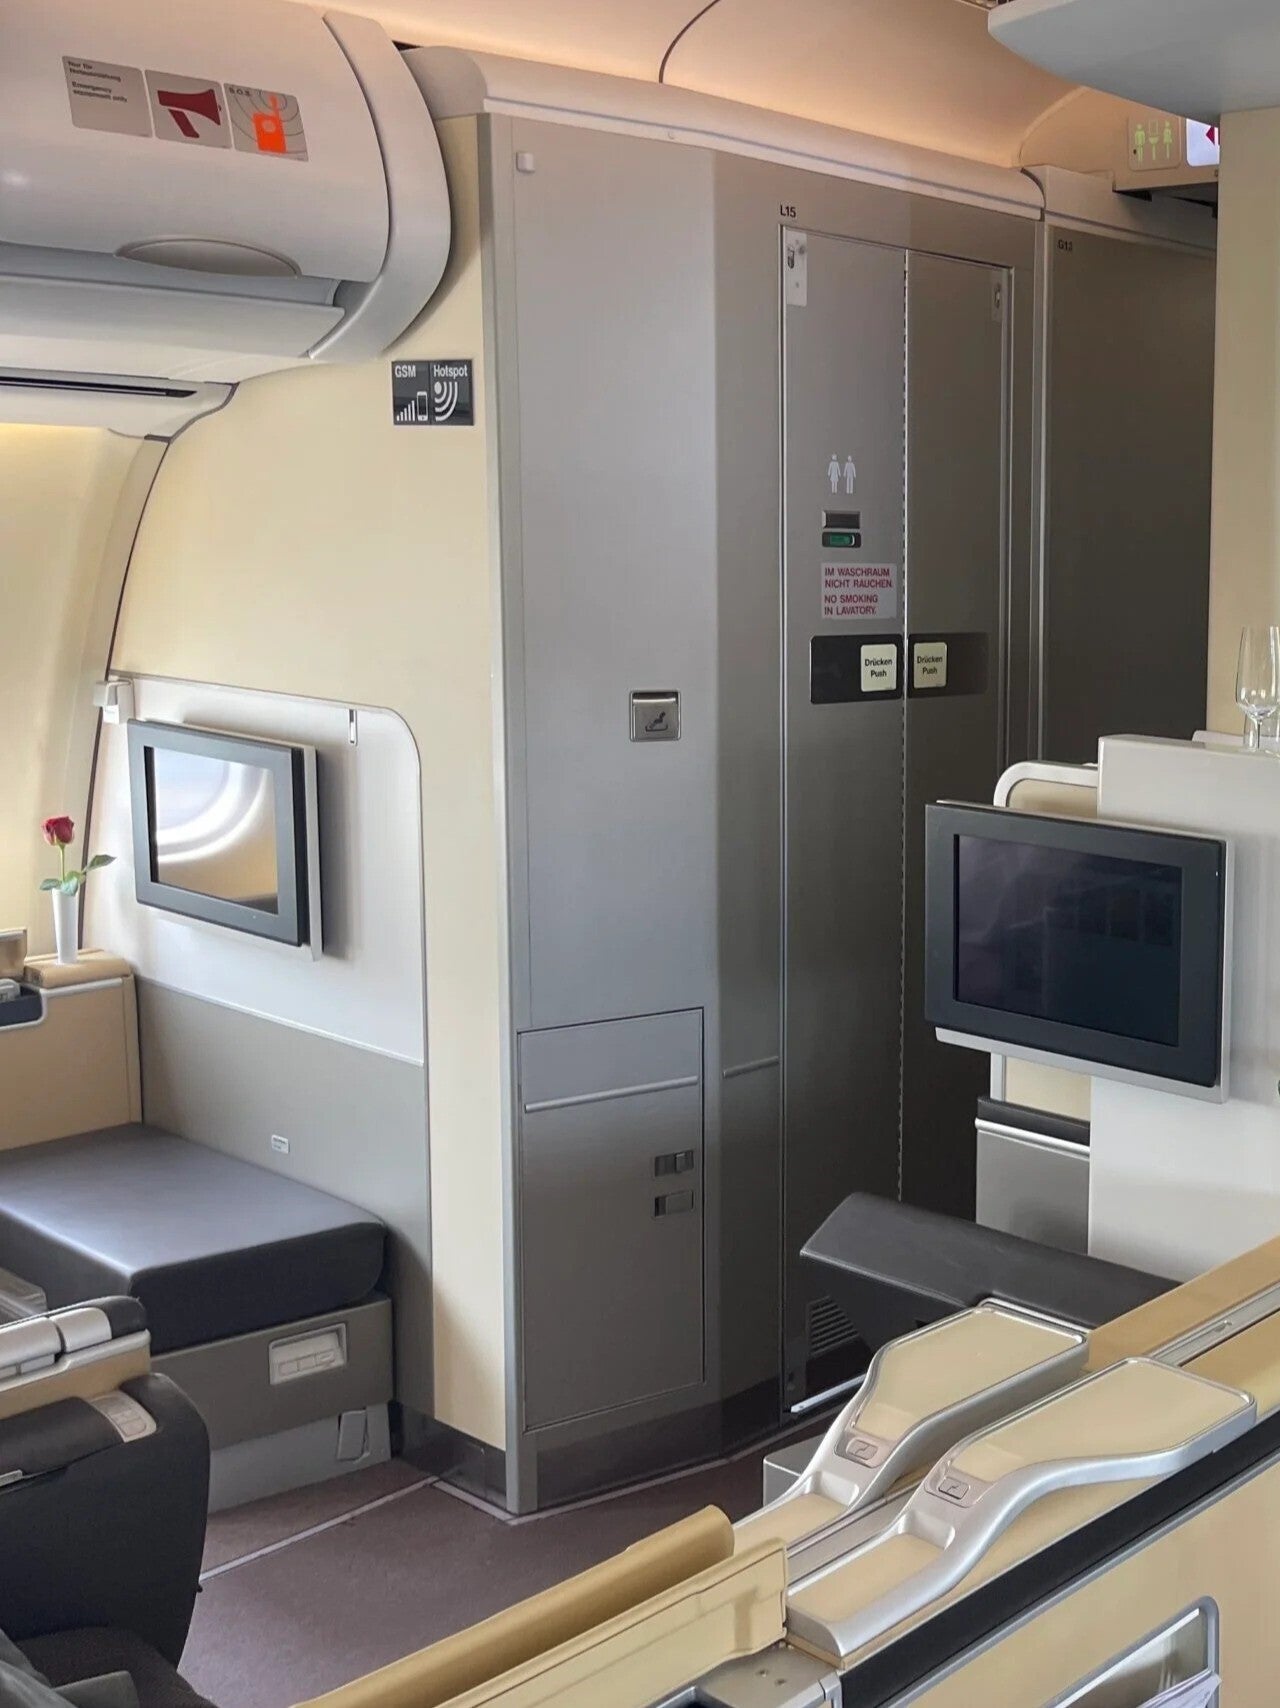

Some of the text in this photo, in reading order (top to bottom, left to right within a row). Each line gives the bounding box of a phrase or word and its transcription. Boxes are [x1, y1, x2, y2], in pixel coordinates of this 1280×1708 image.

[780, 205, 797, 218] L15
[394, 364, 468, 379] GSM Hotspot
[825, 567, 890, 577] IM WASCHRAUM
[825, 579, 850, 588] NICHT
[824, 594, 878, 604] NO SMOKING
[824, 606, 833, 615] IN
[864, 658, 893, 667] Drücken
[917, 656, 943, 664] Drücken
[870, 669, 888, 678] Push
[922, 667, 938, 675] Push
